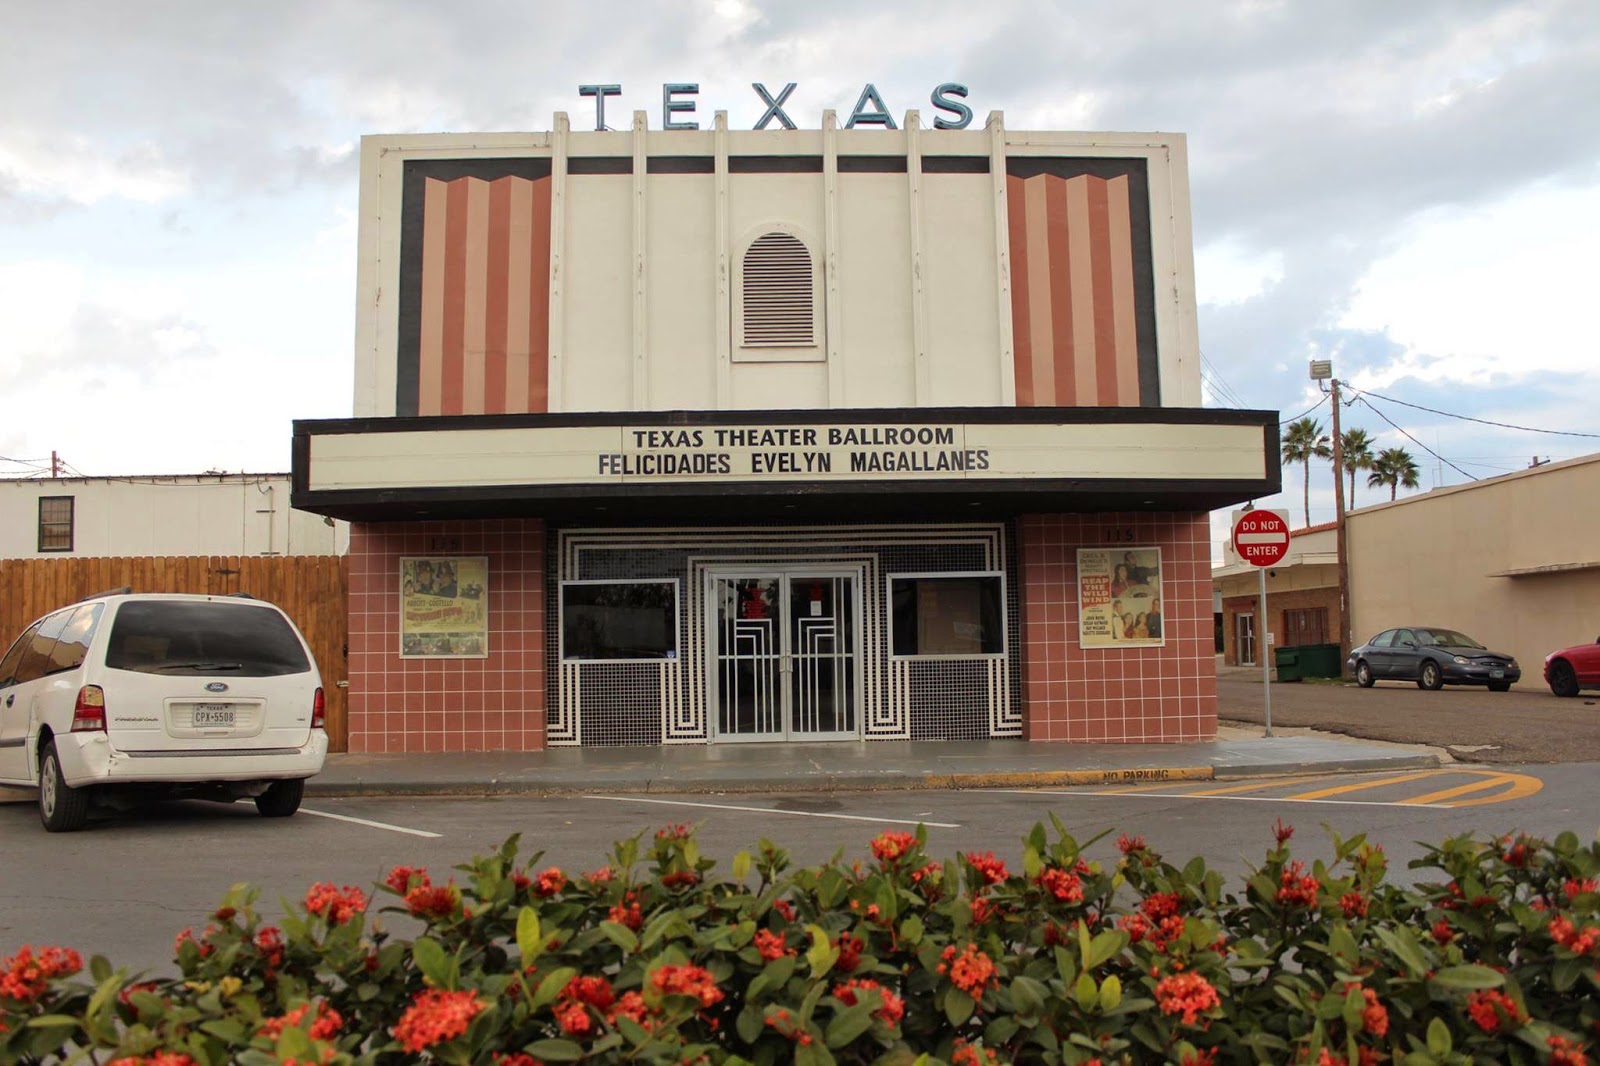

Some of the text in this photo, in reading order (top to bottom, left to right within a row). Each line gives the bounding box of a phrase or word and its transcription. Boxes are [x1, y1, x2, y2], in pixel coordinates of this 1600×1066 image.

[578, 82, 974, 131] TEXAS
[632, 427, 954, 448] TEXAS THEATER BALLROOM
[598, 449, 990, 475] FELICIDADES EVELYN MAGALLANES
[1242, 520, 1280, 531] DO NOT
[1106, 529, 1133, 541] 115
[1246, 546, 1278, 556] ENTER
[1081, 577, 1109, 585] REAP
[1082, 596, 1110, 604] WIND
[1103, 769, 1169, 781] NO PARKING
